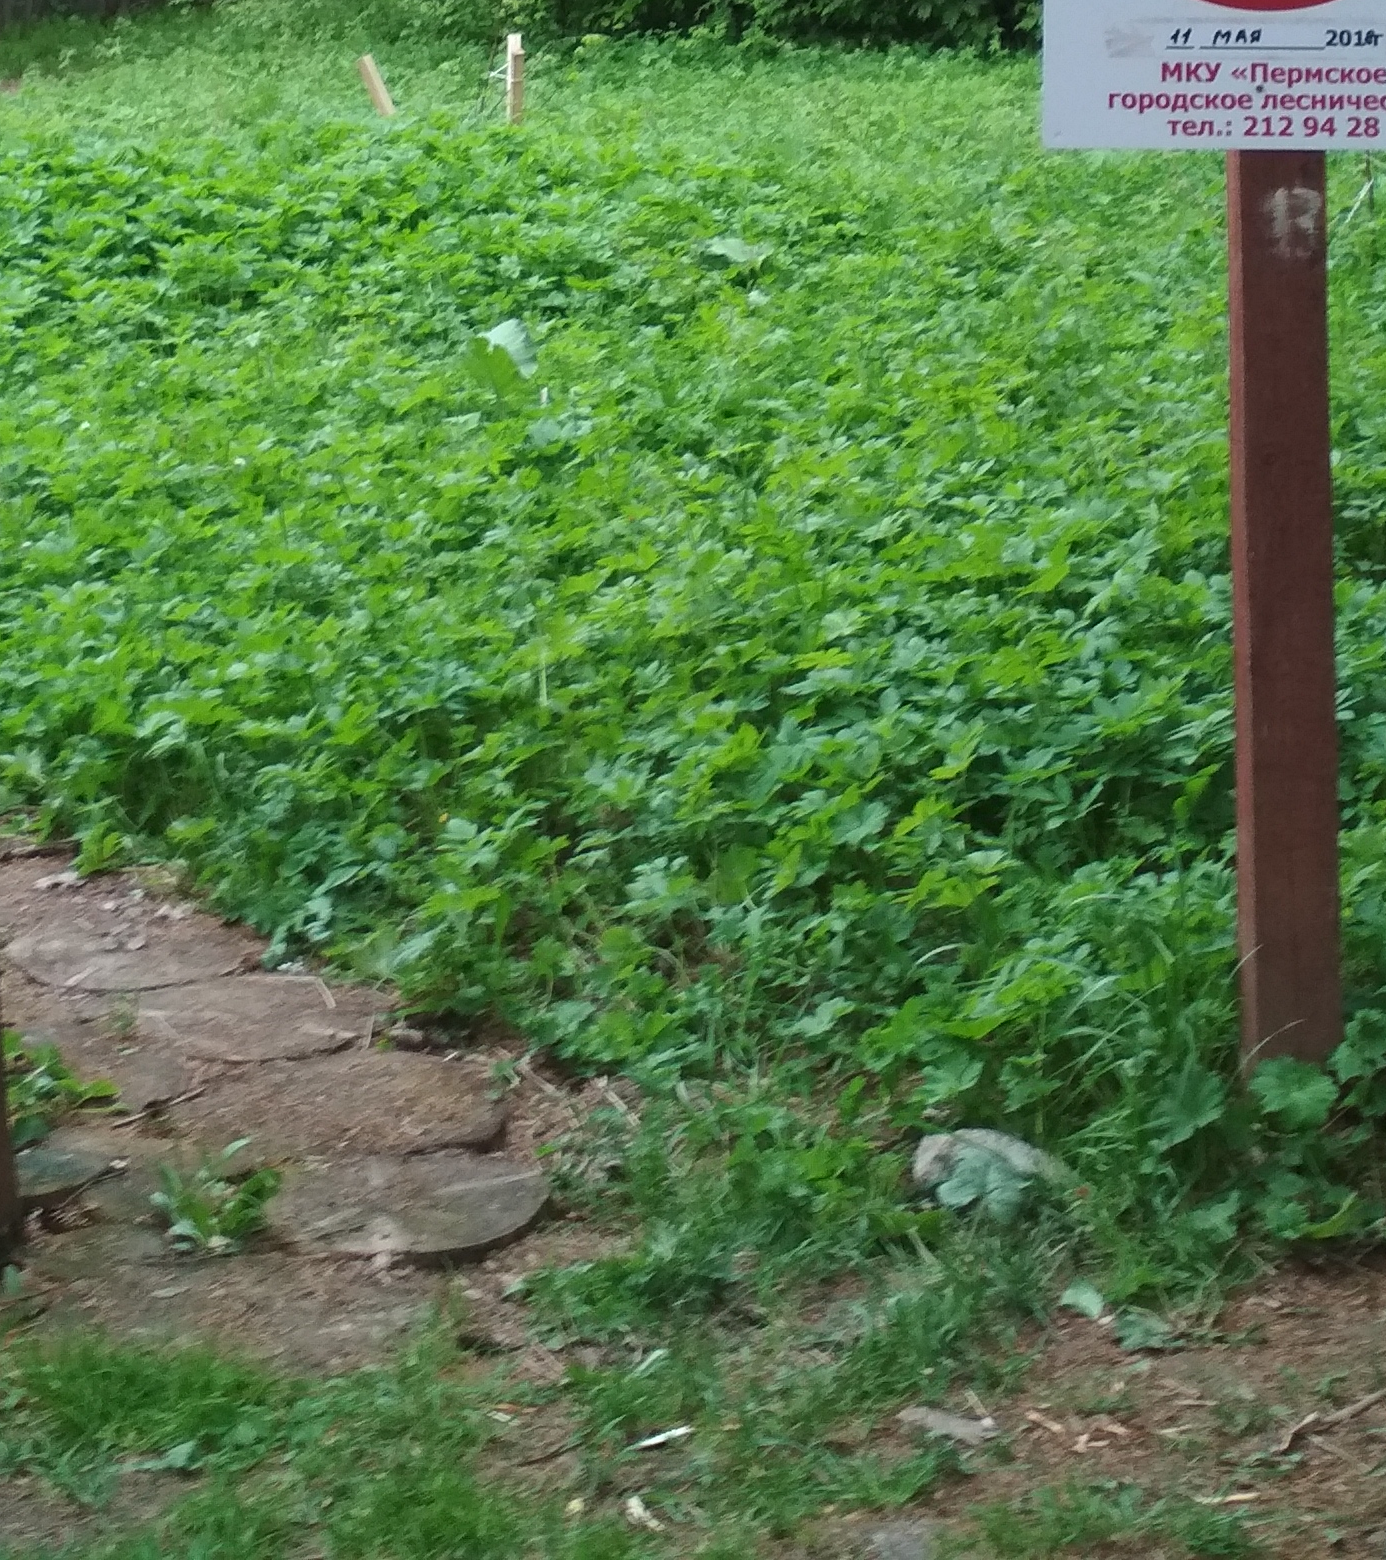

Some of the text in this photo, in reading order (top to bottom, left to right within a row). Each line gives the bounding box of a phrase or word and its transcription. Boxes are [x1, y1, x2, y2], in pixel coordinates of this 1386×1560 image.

[1212, 28, 1263, 46] МАЯ
[1160, 62, 1222, 84] МКУ
[1108, 93, 1253, 114] городское
[1166, 116, 1381, 138] тел.: 212 94 28
